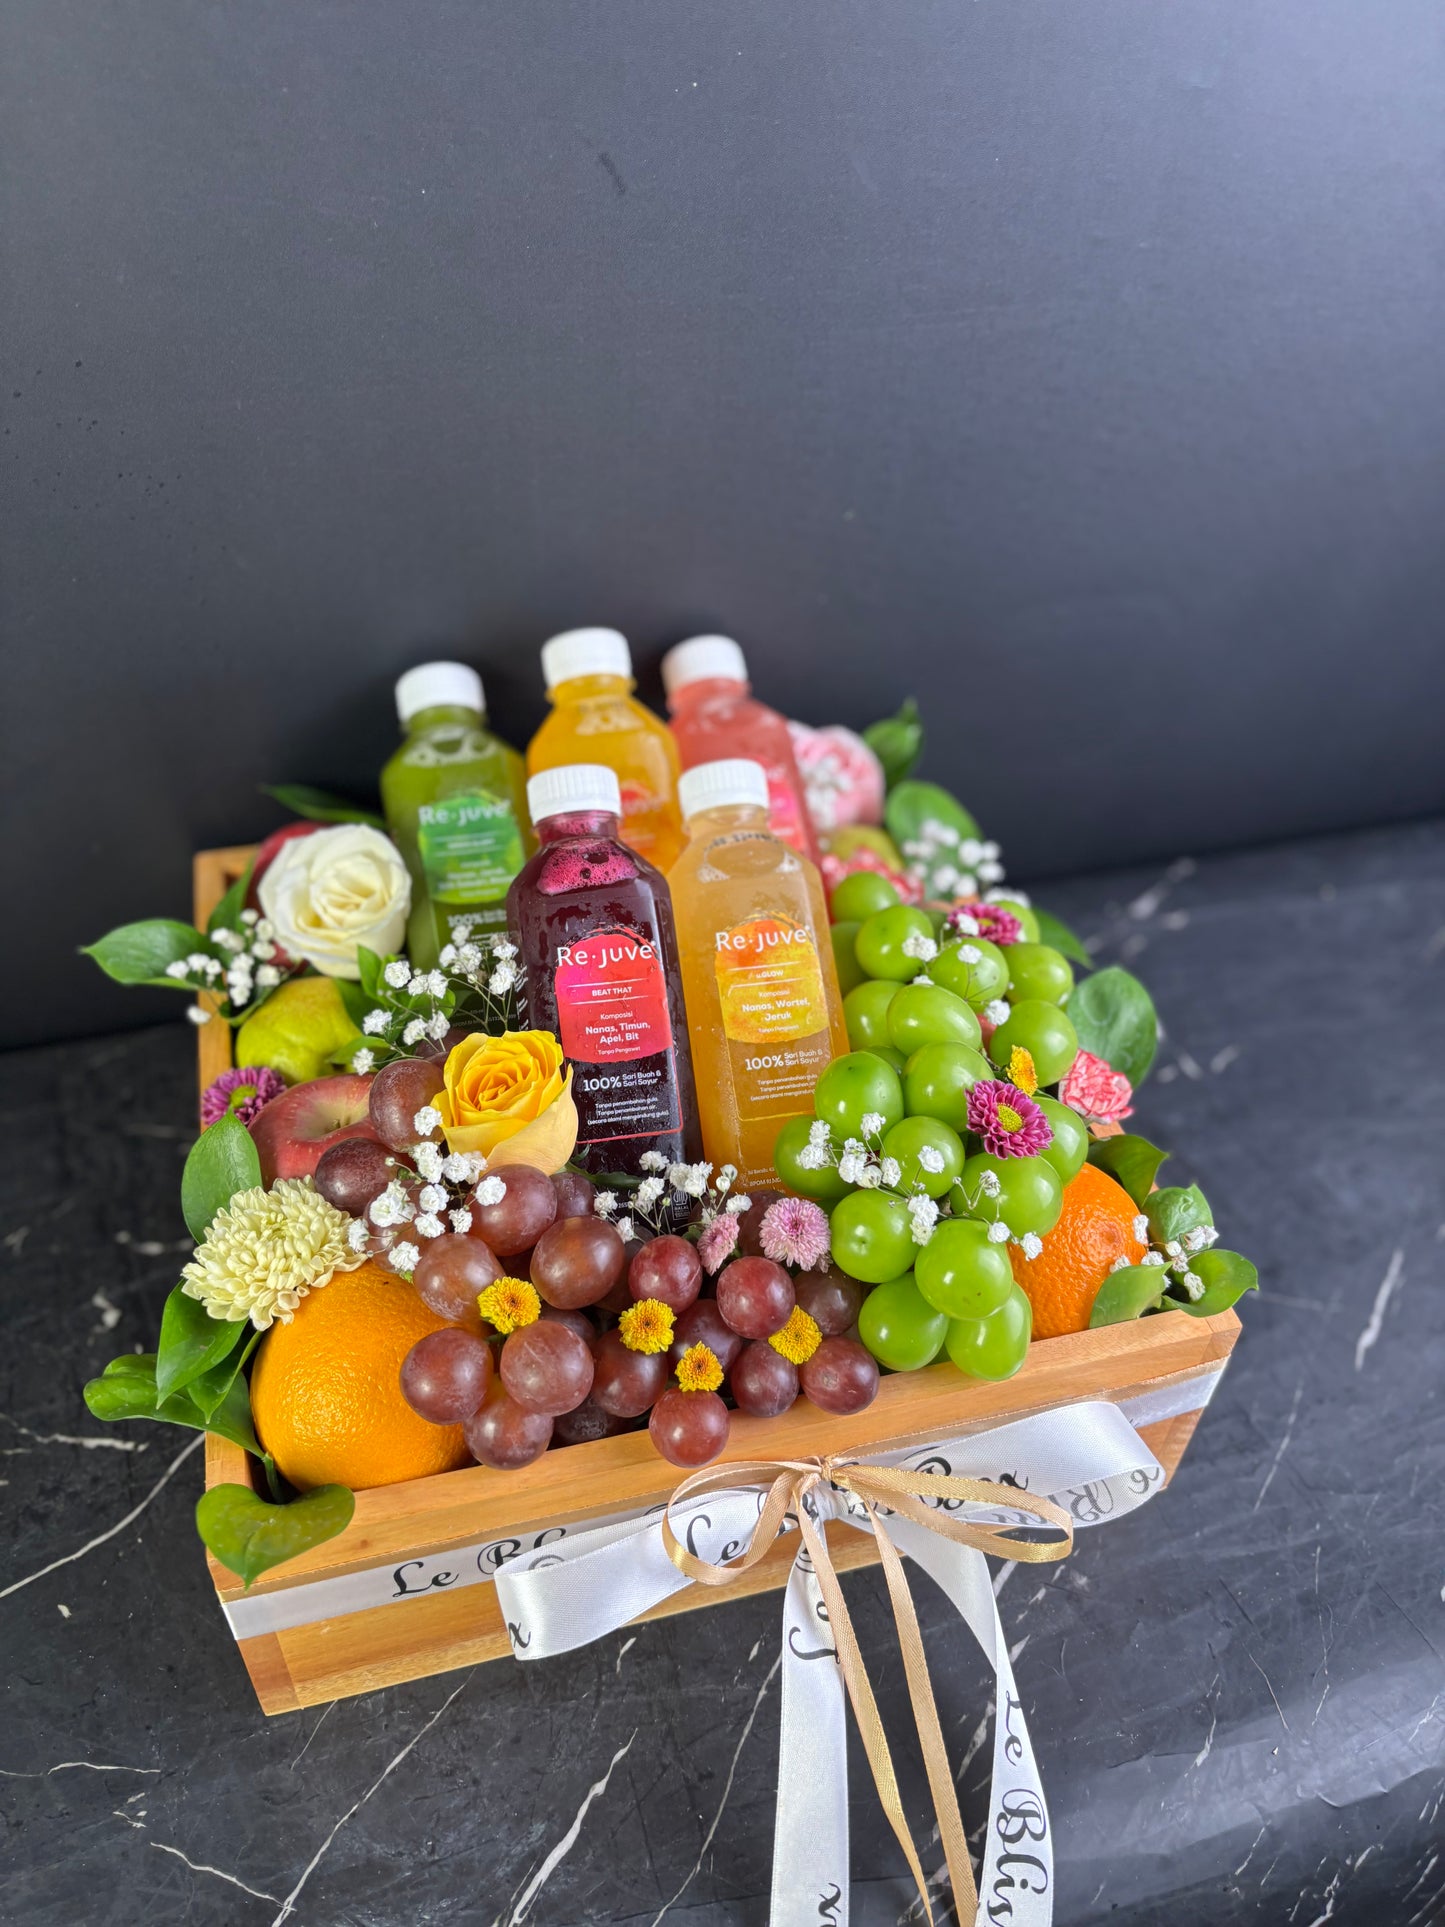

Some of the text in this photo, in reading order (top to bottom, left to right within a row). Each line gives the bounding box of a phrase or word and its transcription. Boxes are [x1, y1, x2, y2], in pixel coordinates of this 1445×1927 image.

[592, 986, 632, 997] BEAT THAT
[742, 998, 810, 1012] Nanas, Wortel,
[600, 1011, 633, 1021] Komposisi
[764, 1011, 791, 1022] Jeruk
[585, 1021, 651, 1035] Nanas, Timun,
[599, 1032, 639, 1046] Apel, Bit
[799, 1050, 816, 1058] Buah
[745, 1055, 784, 1071] 100%
[800, 1057, 819, 1066] Sayur
[637, 1071, 655, 1079] Buah
[583, 1076, 622, 1092] 100%
[638, 1078, 658, 1087] Sayur
[392, 1561, 459, 1597] Le
